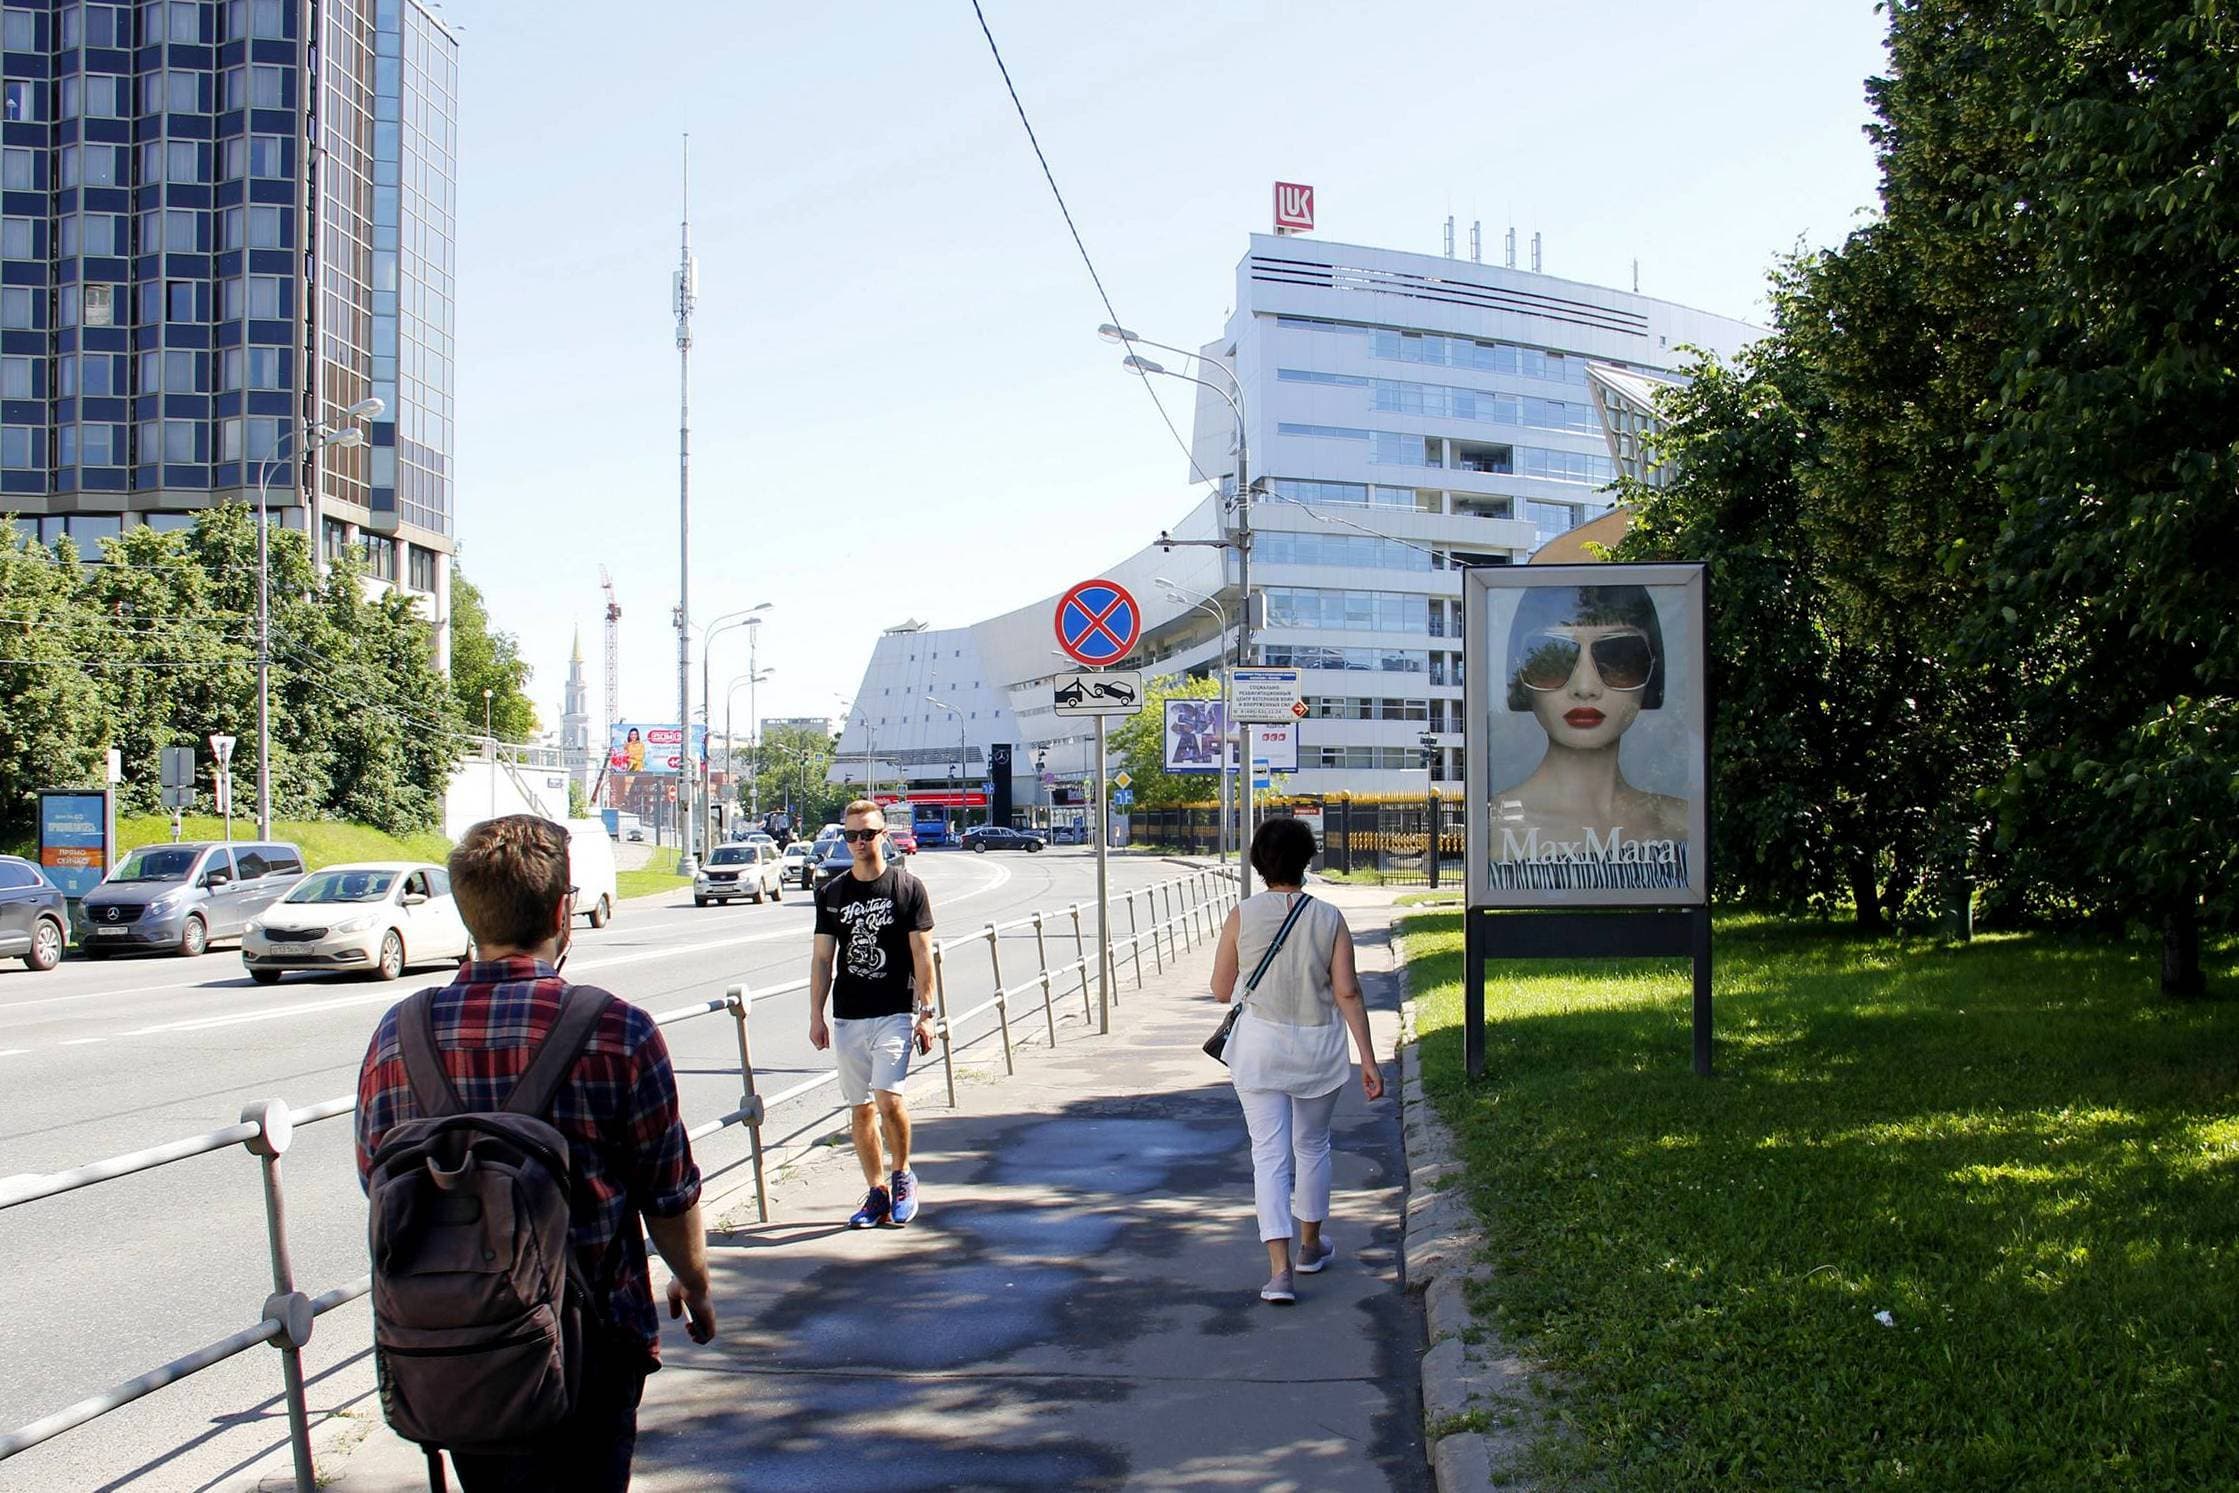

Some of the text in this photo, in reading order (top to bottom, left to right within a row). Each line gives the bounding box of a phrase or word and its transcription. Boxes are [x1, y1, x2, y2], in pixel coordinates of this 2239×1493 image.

[1499, 826, 1676, 865] MaxMara
[840, 898, 894, 924] Heritage
[865, 912, 894, 931] Ride
